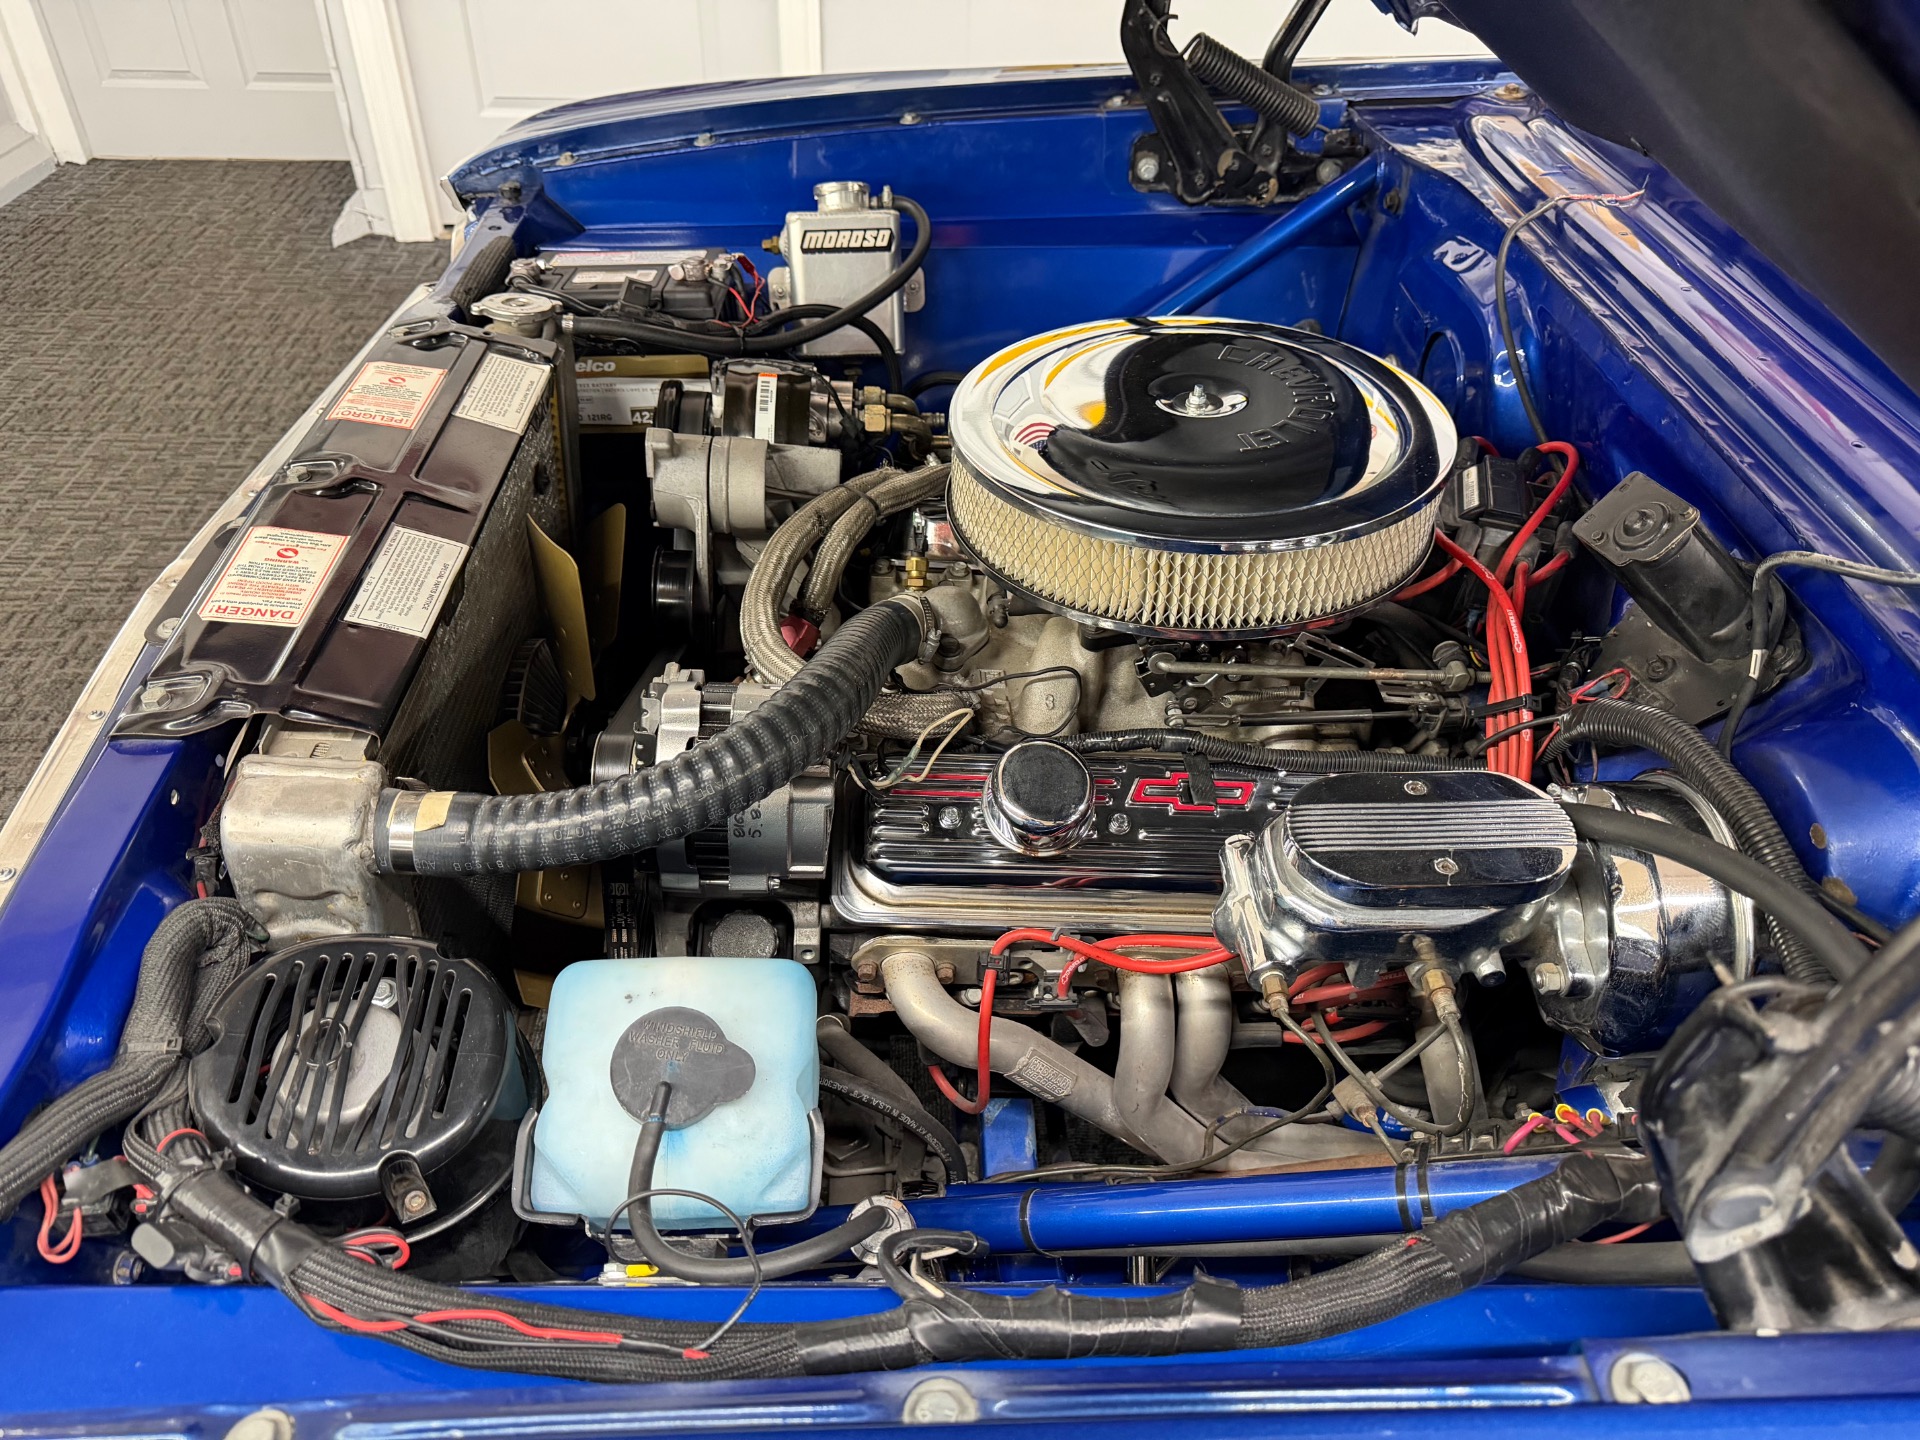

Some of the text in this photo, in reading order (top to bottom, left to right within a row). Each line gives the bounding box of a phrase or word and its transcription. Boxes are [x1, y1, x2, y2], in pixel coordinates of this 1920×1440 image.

[803, 230, 891, 249] MOROSO
[575, 360, 616, 372] elco
[1217, 345, 1336, 453] CHEVROLET
[421, 562, 450, 610] SPECIAL PARTS NOTICE
[208, 604, 295, 619] DANGER!
[692, 772, 737, 801] MADE
[616, 805, 652, 831] MEX
[553, 826, 584, 840] 070
[643, 1020, 718, 1040] WINDSHIELD
[629, 1031, 725, 1055] WASHER FLUID
[656, 1049, 689, 1062] ONLY
[898, 1111, 919, 1131] MADE
